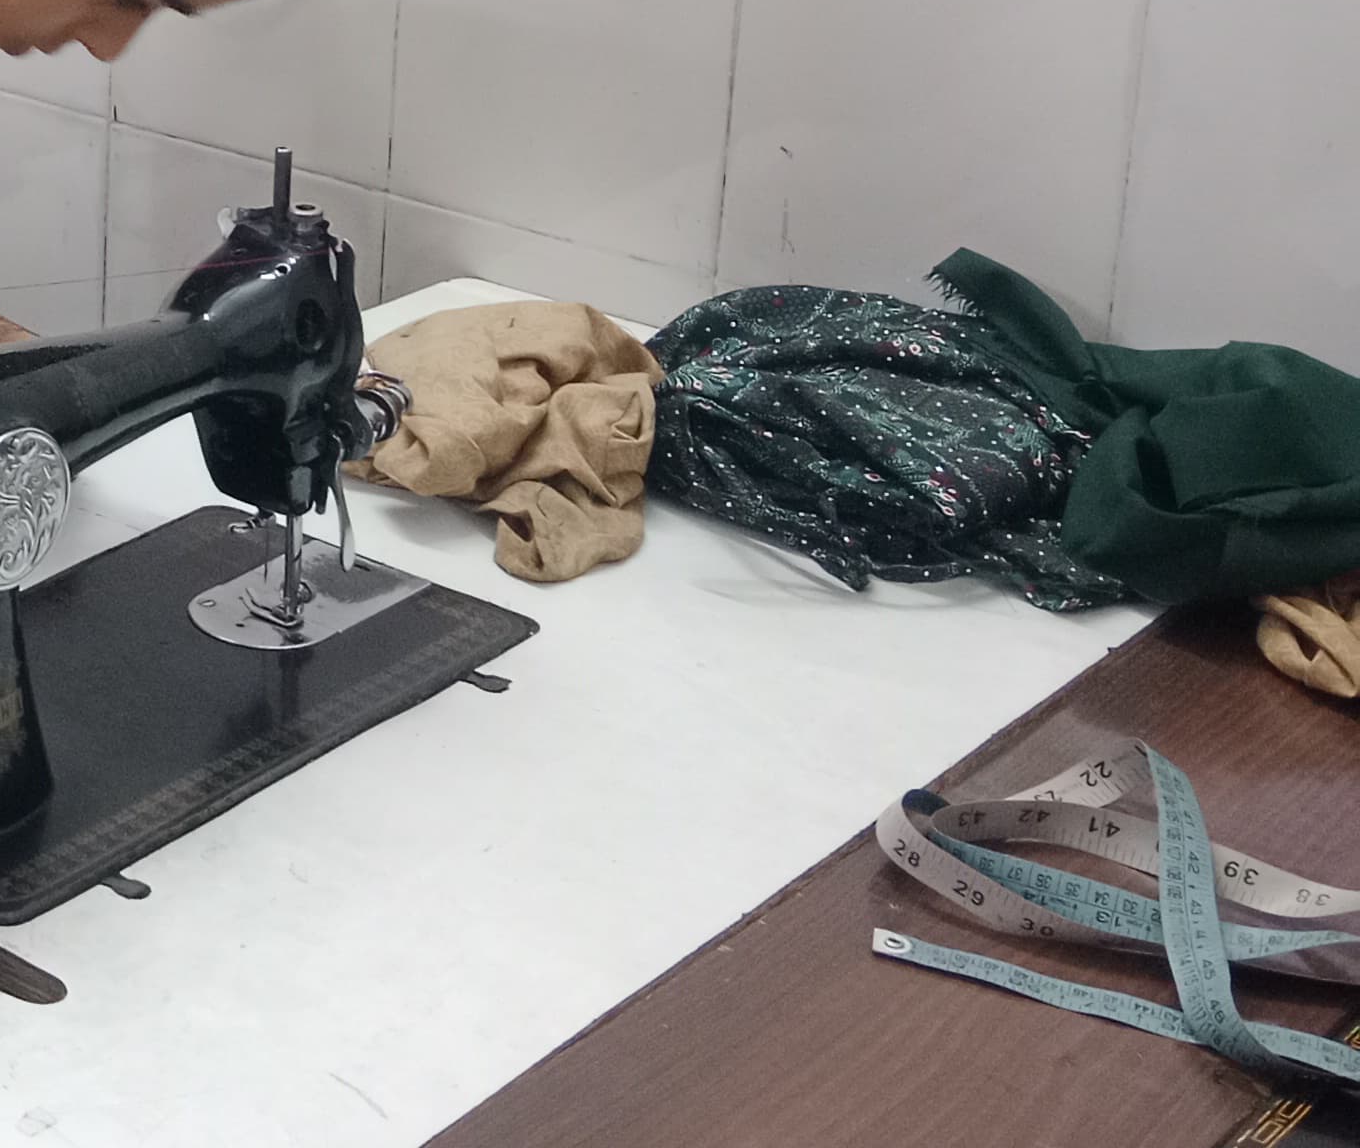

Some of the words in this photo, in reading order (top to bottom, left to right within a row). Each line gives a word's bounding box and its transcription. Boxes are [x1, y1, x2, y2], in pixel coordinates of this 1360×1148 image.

[1187, 850, 1200, 874] 42
[1224, 860, 1259, 886] 39
[892, 838, 923, 868] 28
[952, 879, 985, 906] 29
[1020, 917, 1055, 938] 30
